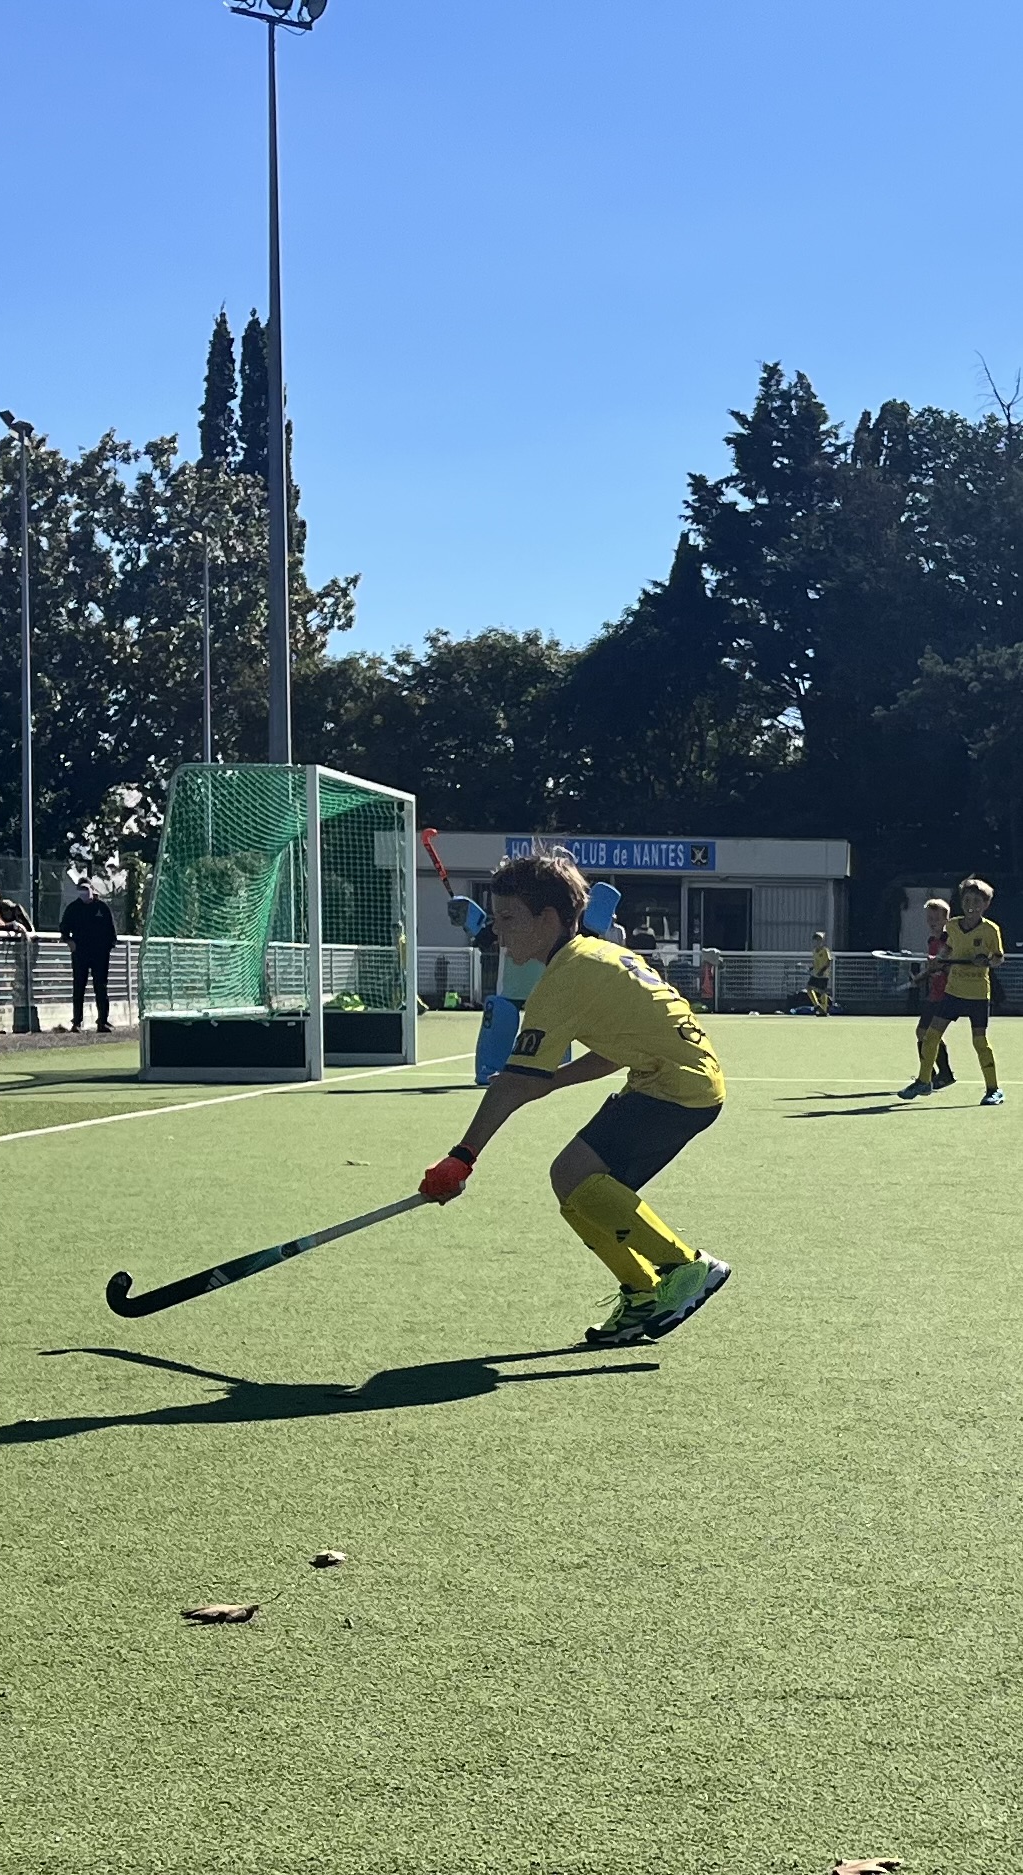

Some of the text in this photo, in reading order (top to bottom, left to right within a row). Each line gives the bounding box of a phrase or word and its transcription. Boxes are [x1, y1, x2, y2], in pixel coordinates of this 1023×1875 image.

[572, 842, 607, 866] CLUB
[613, 844, 627, 866] de
[633, 843, 685, 867] NANTES
